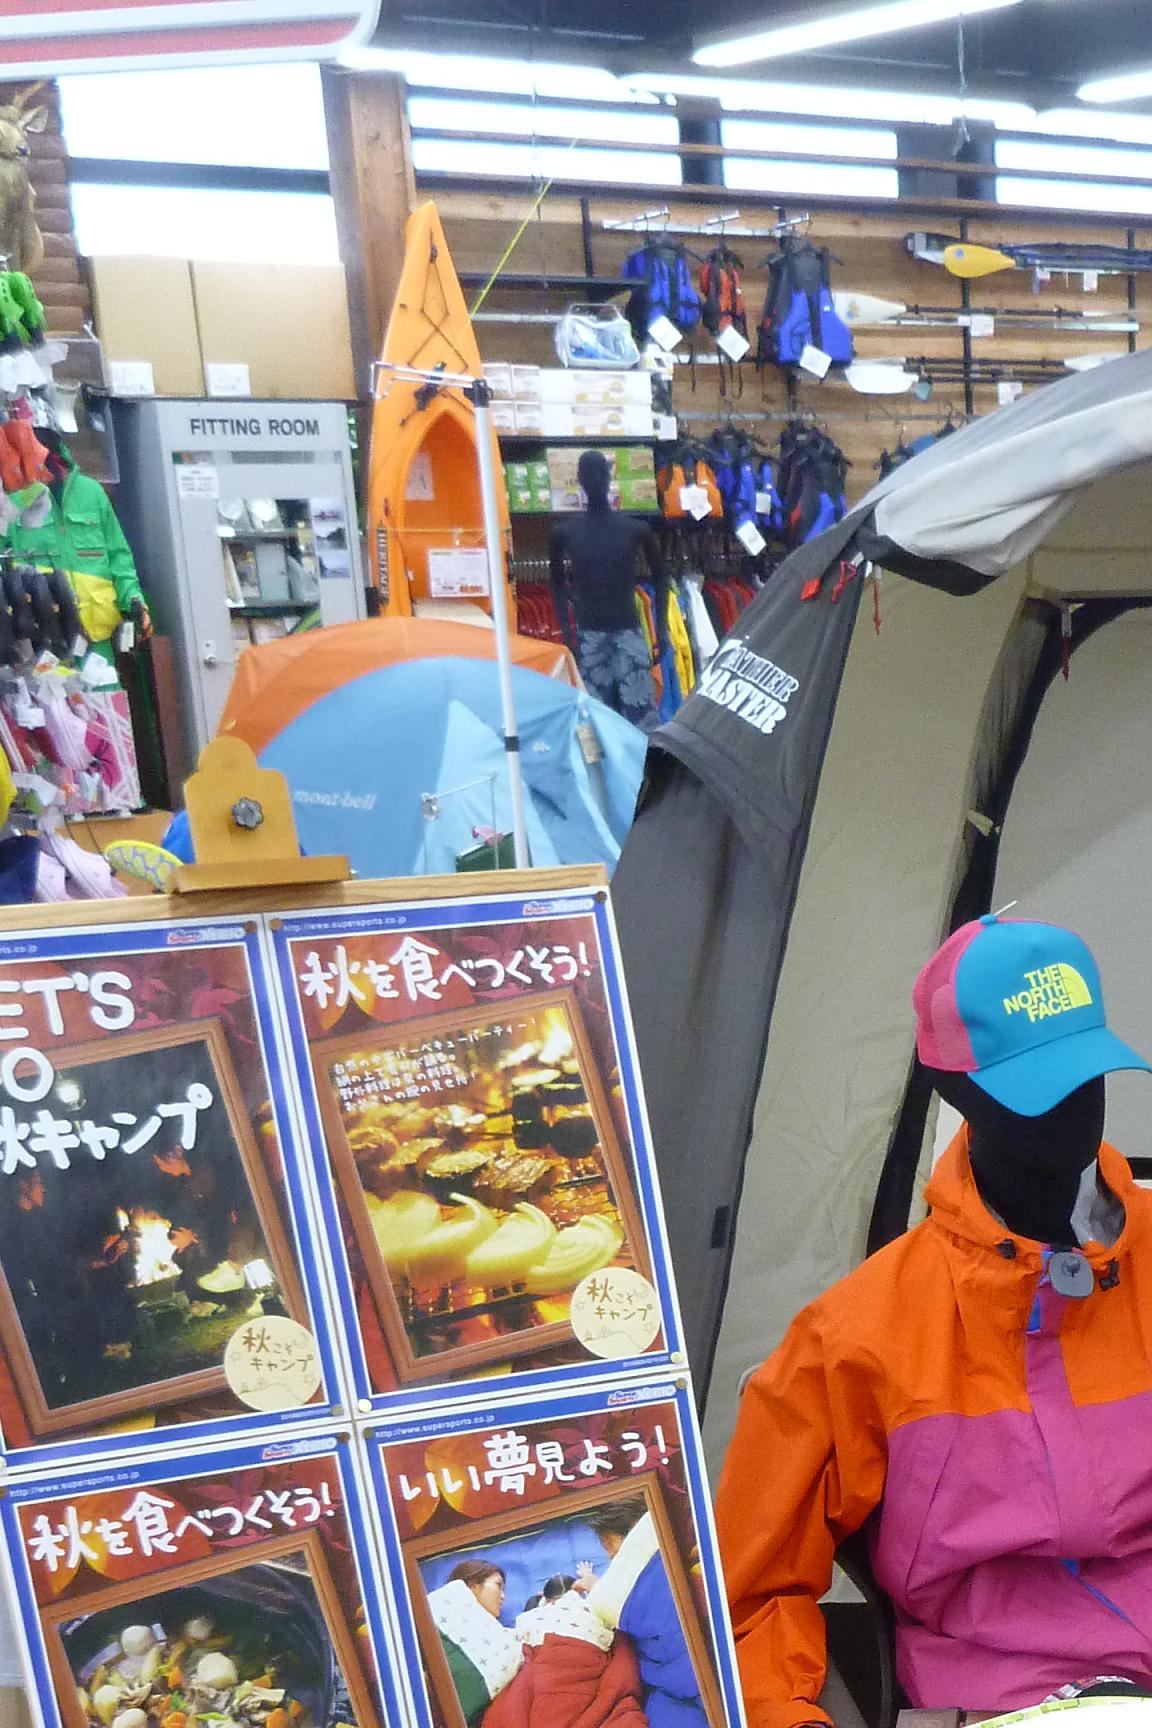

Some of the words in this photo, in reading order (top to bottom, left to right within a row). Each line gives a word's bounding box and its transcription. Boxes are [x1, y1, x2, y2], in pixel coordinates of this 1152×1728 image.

[190, 418, 261, 435] FITTING
[269, 418, 320, 436] ROOM
[1024, 963, 1060, 988] THE
[1003, 979, 1067, 1015] NORTH
[1027, 995, 1073, 1023] FACE
[586, 1277, 634, 1305] 秋こそ
[594, 1303, 653, 1321] キャンプ
[242, 1326, 293, 1356] 秋こそ
[250, 1354, 314, 1373] キャンプ
[375, 1414, 495, 1438] http://www.supersports.co.jp
[399, 1425, 669, 1500] いい夢見よう！
